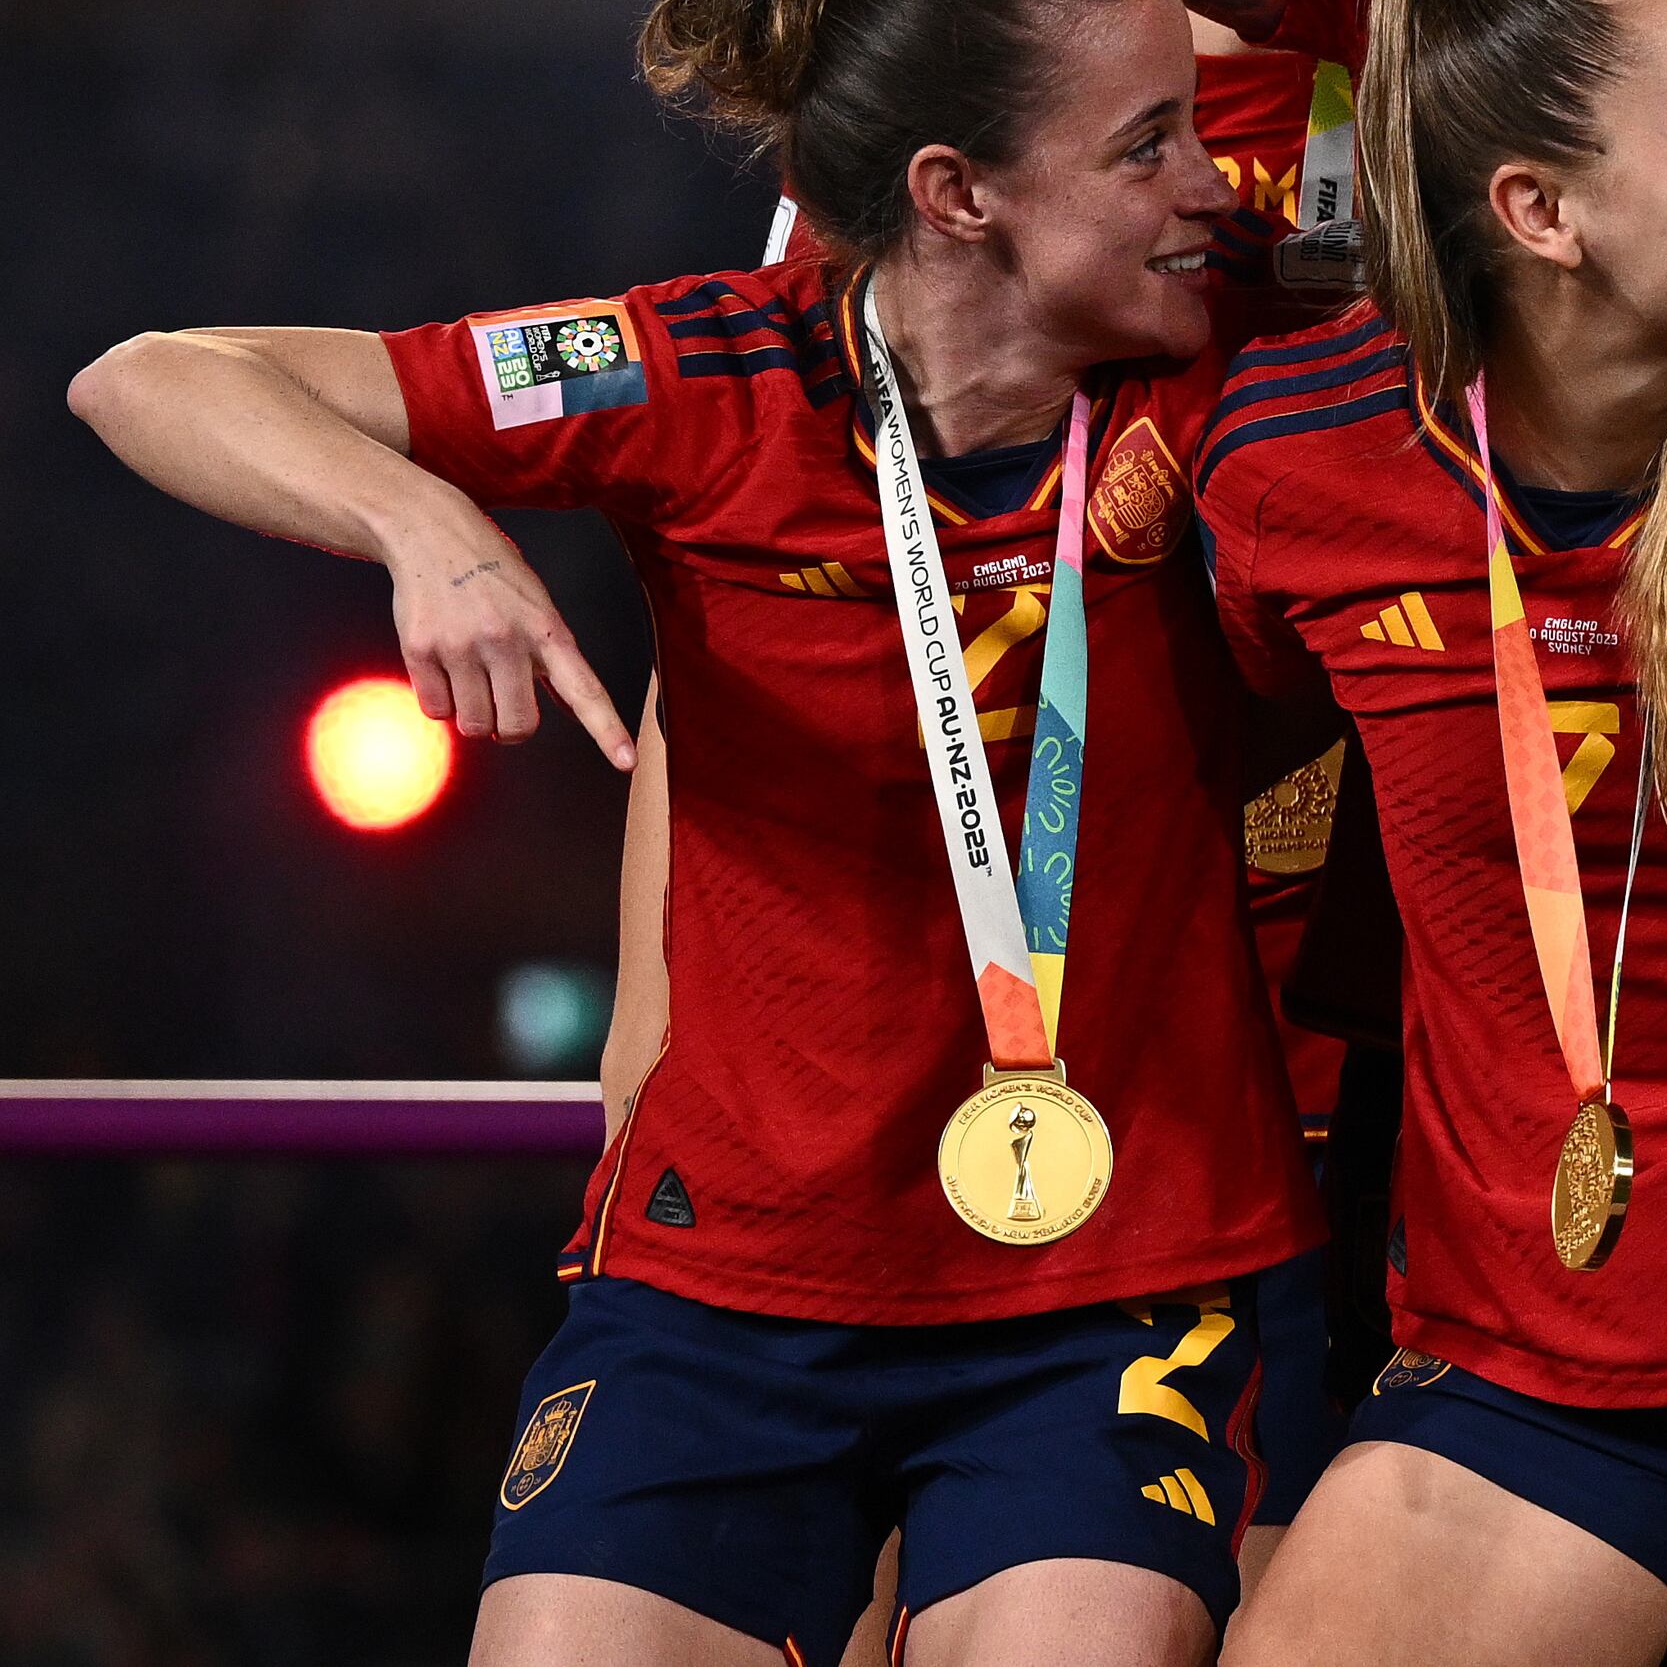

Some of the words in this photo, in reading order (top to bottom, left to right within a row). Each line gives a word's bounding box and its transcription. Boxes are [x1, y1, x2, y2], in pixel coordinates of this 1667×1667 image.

[1317, 177, 1338, 222] FIFA
[491, 331, 511, 357] NZ
[504, 330, 524, 353] AU
[497, 361, 517, 389] 23
[511, 357, 531, 386] 20
[531, 354, 542, 372] CUP
[870, 362, 894, 419] FIFA
[886, 414, 922, 541] WOMEN'S
[906, 540, 940, 637] WORLD
[925, 639, 952, 694] CUP
[973, 554, 1028, 577] ENGLAND
[973, 570, 1019, 589] AUGUST
[1021, 561, 1052, 580] 2023
[1541, 629, 1585, 643] AUGUST
[1589, 633, 1618, 645] 2023
[1545, 617, 1598, 632] ENGLAND
[1548, 642, 1592, 655] SYDNEY
[1036, 1084, 1074, 1106] WORLD
[1074, 1105, 1094, 1124] CUP
[1117, 1281, 1237, 1443] 2
